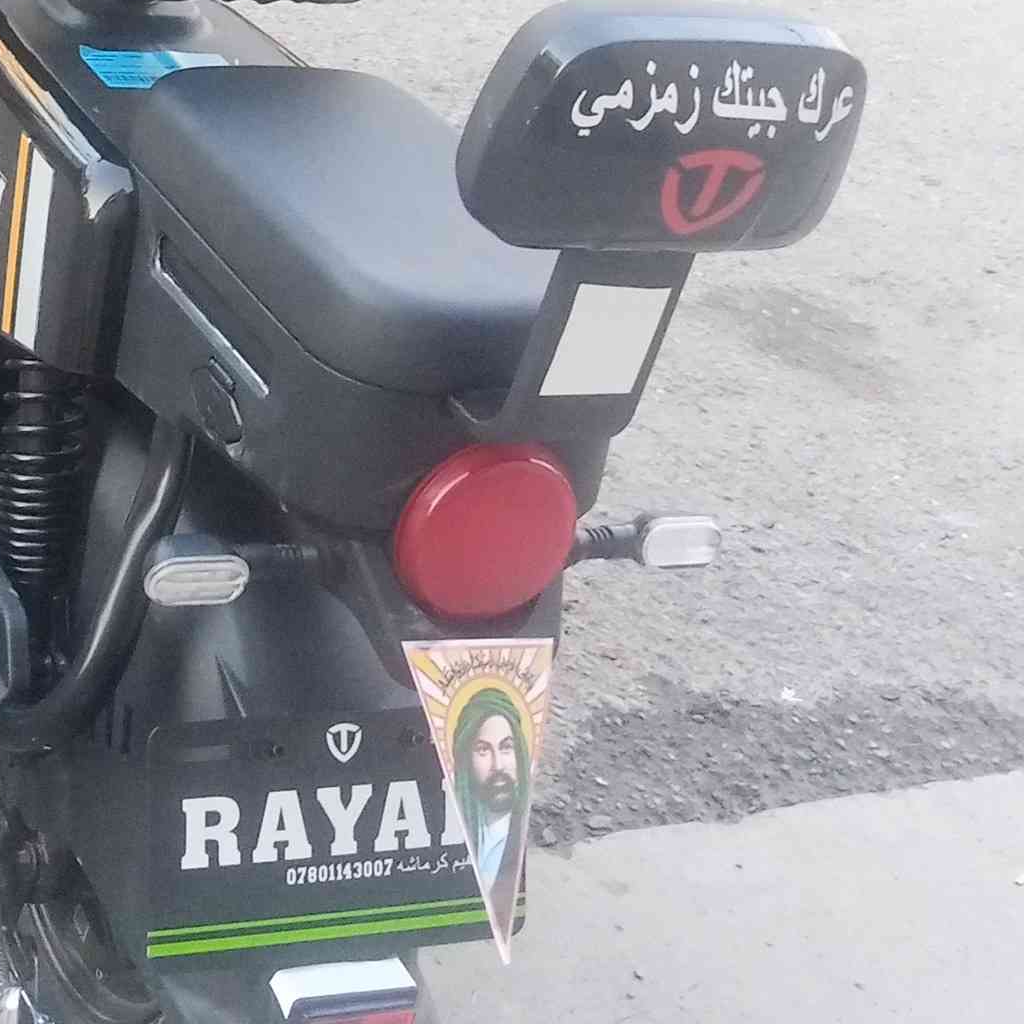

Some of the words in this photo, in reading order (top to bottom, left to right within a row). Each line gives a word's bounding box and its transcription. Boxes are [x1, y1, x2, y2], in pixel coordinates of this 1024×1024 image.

[571, 60, 701, 136] زمزمي
[798, 67, 854, 142] عرك
[286, 858, 394, 886] 07801143007
